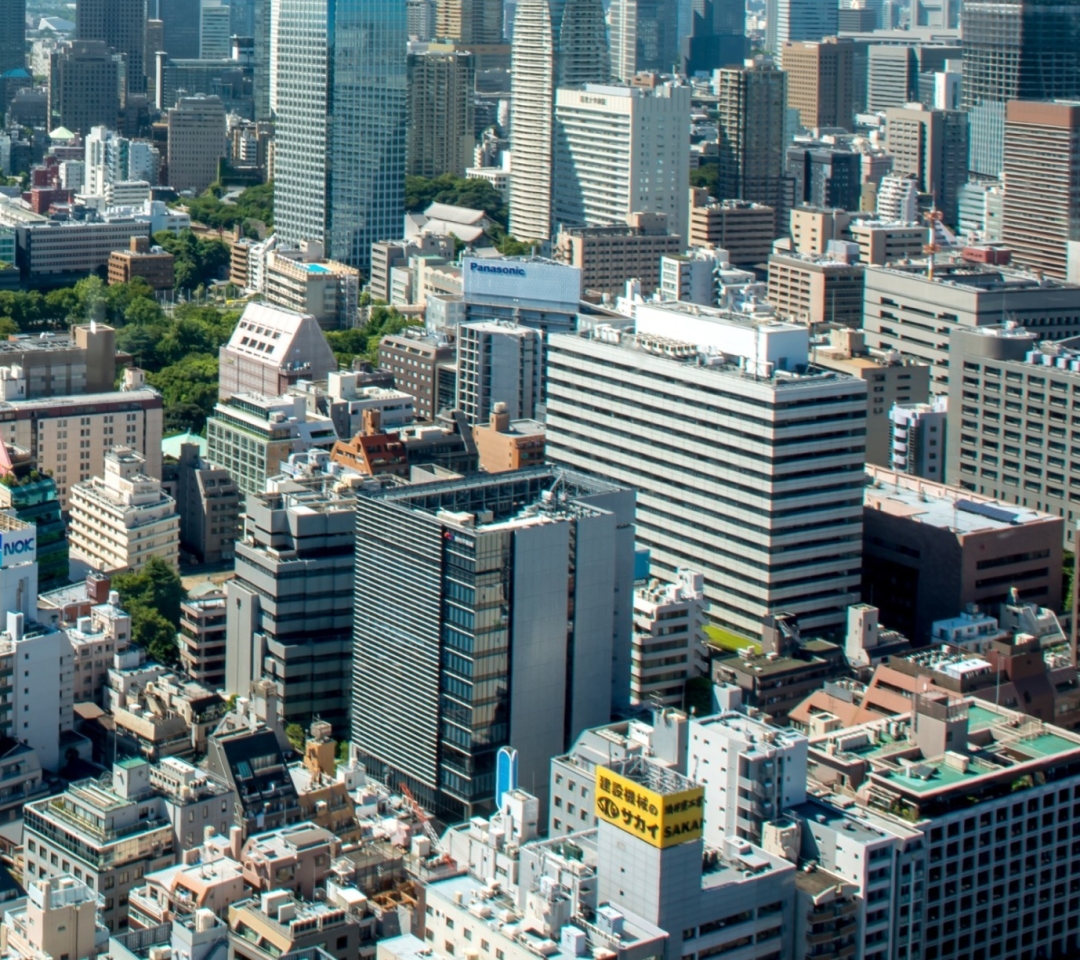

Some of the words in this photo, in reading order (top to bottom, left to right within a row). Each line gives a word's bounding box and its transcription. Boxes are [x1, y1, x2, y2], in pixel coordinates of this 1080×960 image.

[470, 262, 525, 276] Panasonic
[4, 538, 34, 556] NOK
[599, 775, 658, 817] 建設機械の
[621, 807, 659, 840] サカイ
[664, 818, 704, 838] SAKAI
